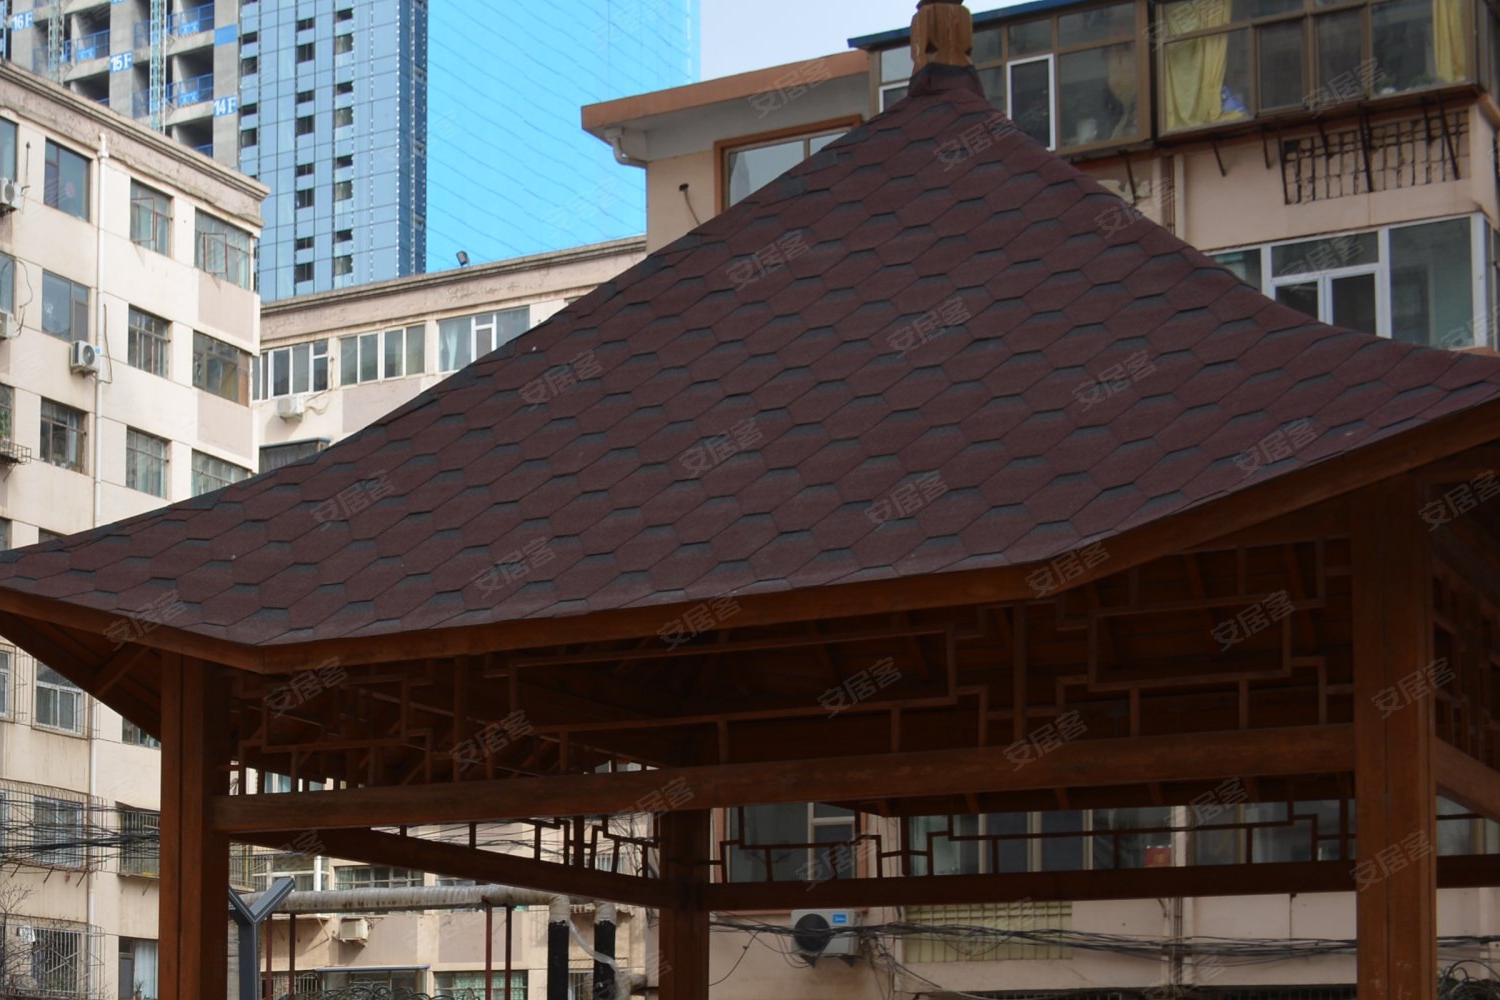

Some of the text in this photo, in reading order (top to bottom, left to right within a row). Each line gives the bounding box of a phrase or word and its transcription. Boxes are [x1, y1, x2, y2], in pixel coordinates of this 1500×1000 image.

[12, 11, 33, 30] 16F
[111, 52, 132, 72] 15F
[214, 97, 237, 116] 14F
